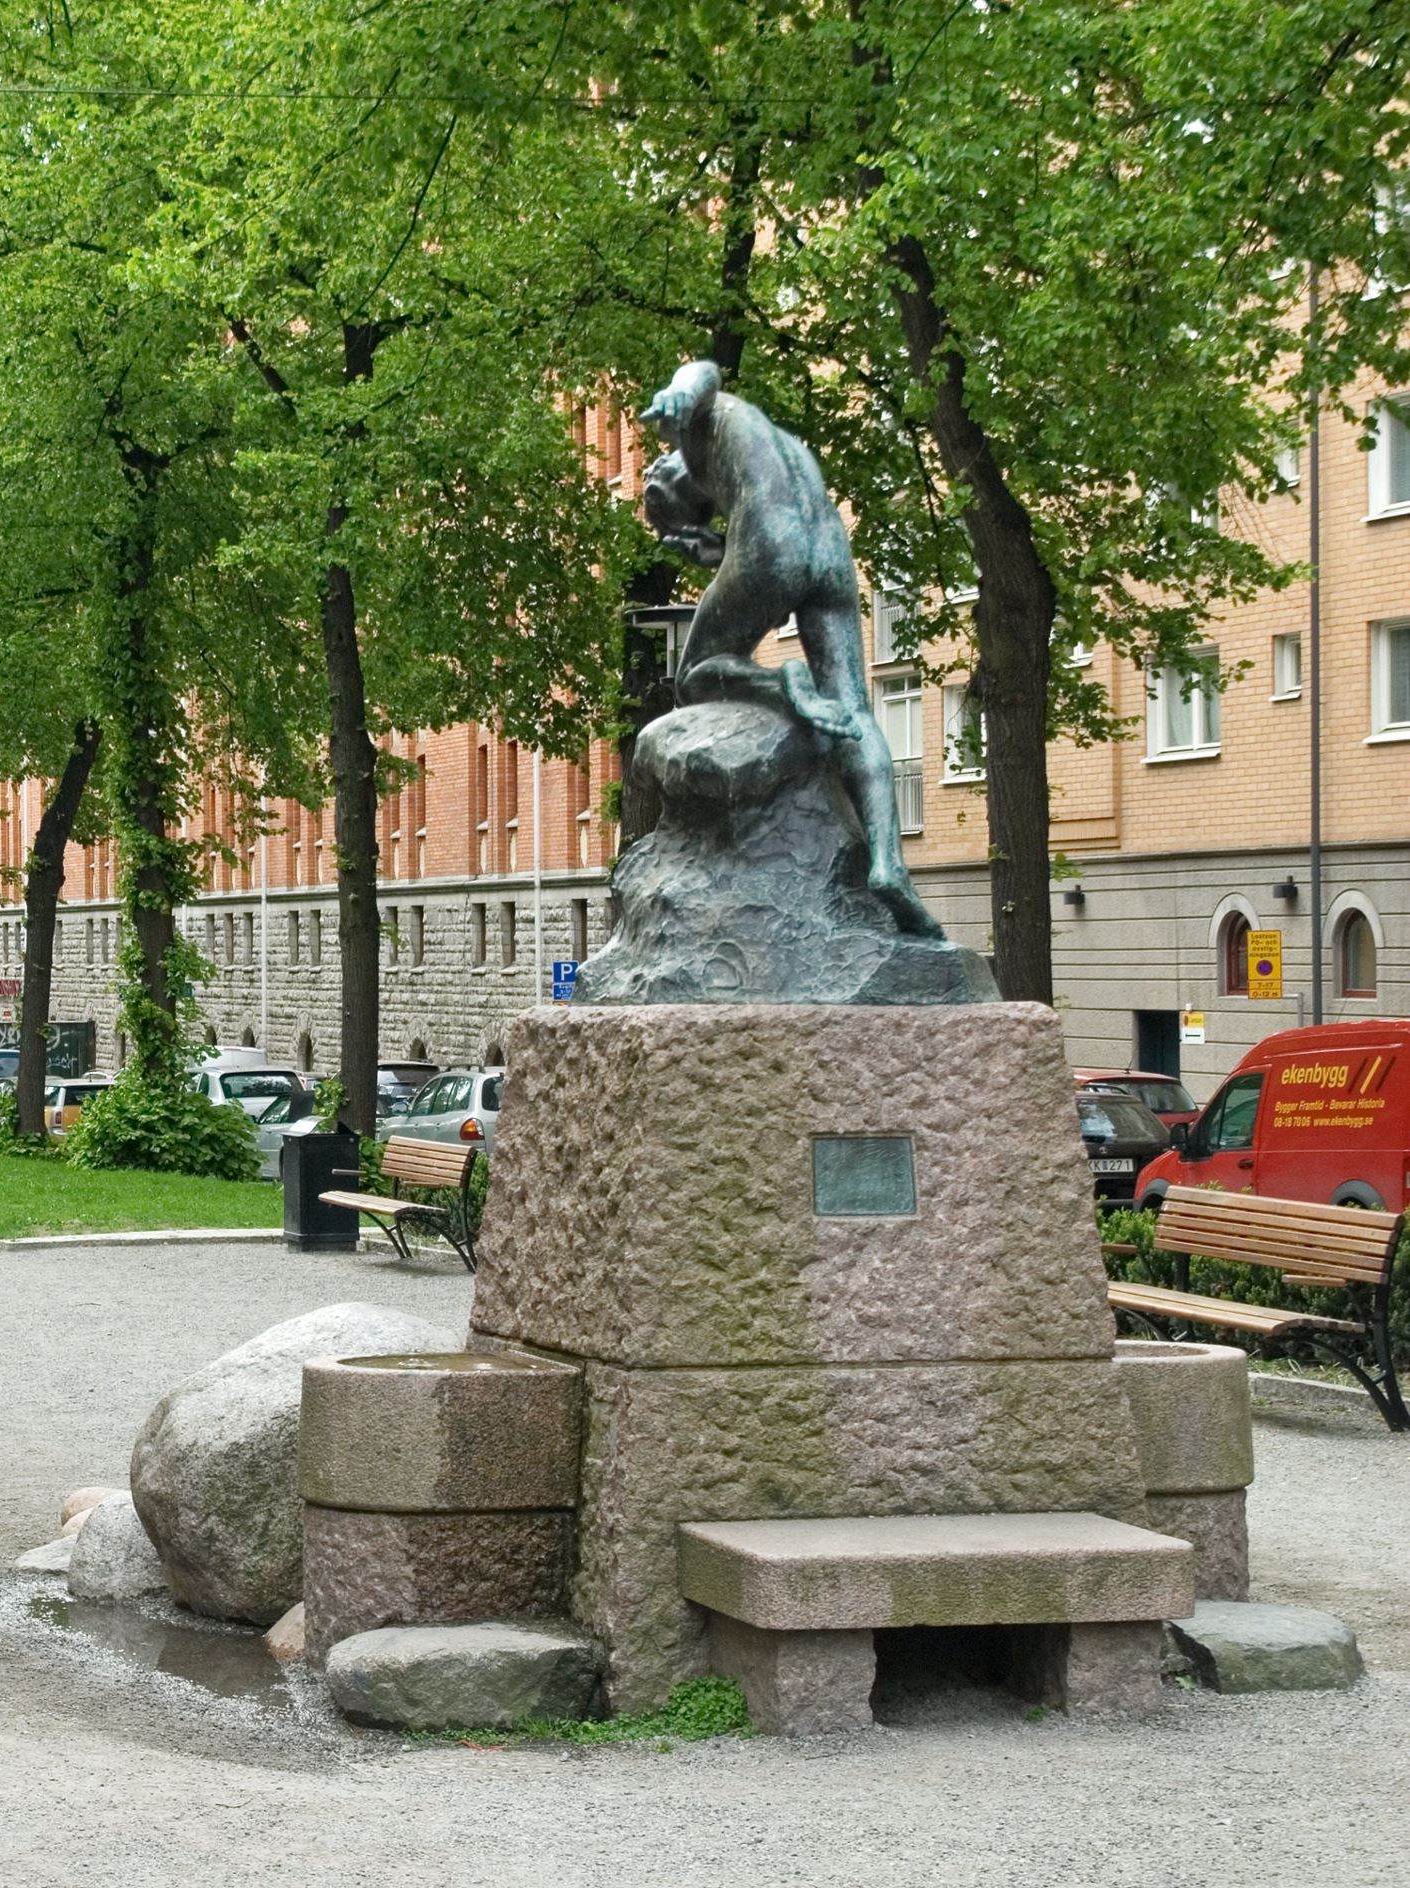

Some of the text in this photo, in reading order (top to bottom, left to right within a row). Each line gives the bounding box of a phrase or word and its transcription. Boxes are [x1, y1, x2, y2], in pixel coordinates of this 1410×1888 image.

[561, 963, 573, 981] P
[1281, 1062, 1349, 1089] ekenbygg
[1274, 1101, 1298, 1114] Bygger
[1298, 1100, 1325, 1111] Framtid
[1330, 1099, 1357, 1110] Bevarar
[1357, 1097, 1386, 1109] Historia
[1313, 1115, 1374, 1129] www.ekenbygg.se
